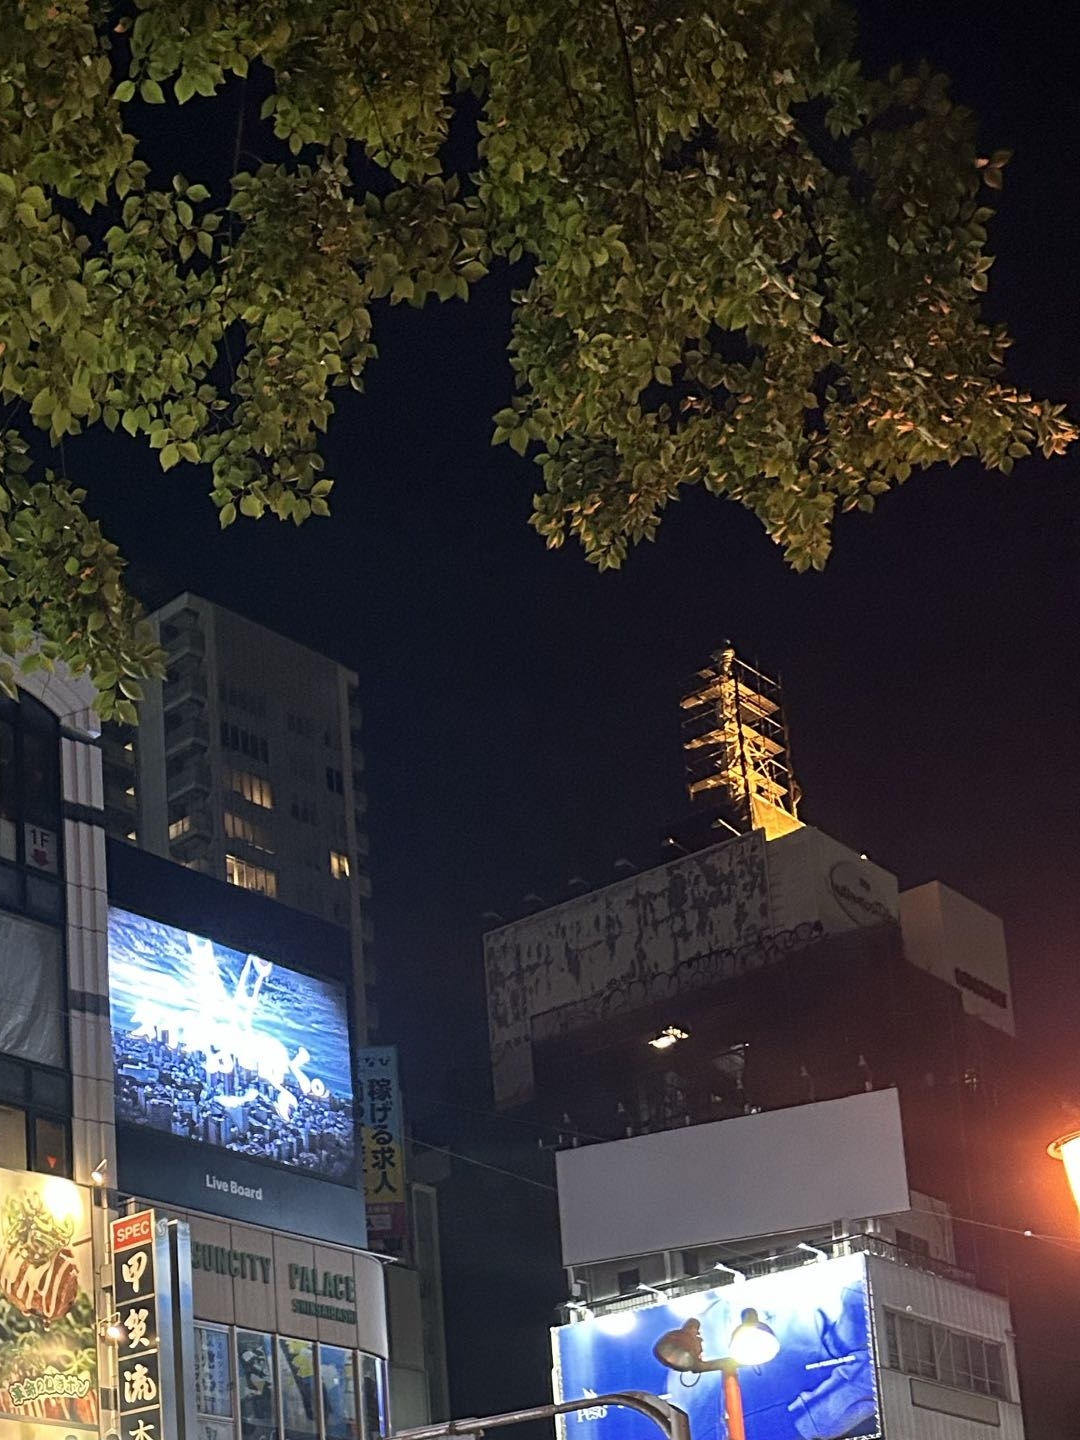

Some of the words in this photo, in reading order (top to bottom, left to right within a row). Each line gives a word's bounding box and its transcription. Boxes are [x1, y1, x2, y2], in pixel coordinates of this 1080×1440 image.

[30, 828, 50, 848] 1F
[367, 1077, 397, 1195] 稼げる求人
[206, 1174, 229, 1193] Live
[230, 1180, 263, 1201] Board
[116, 1220, 151, 1243] SPEC
[288, 1262, 356, 1303] PALACE
